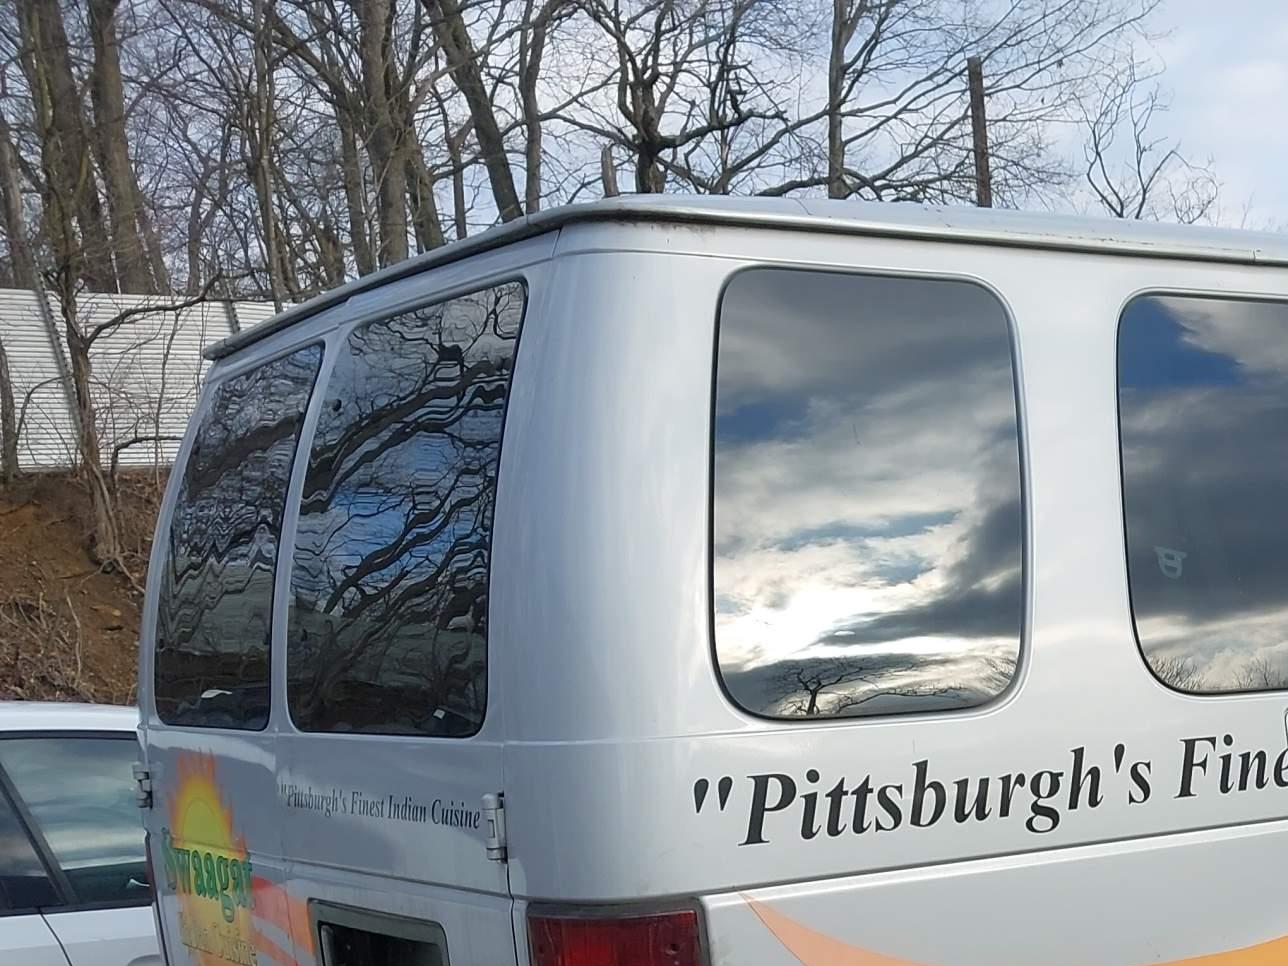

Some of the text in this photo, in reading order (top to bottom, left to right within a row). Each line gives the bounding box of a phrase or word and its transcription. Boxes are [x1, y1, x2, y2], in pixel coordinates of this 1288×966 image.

[350, 791, 385, 818] Finest
[387, 795, 426, 823] Indian
[431, 799, 481, 829] Cuisine
[693, 743, 1154, 848] "Pittsburgh's
[160, 826, 257, 923] Swaagat
